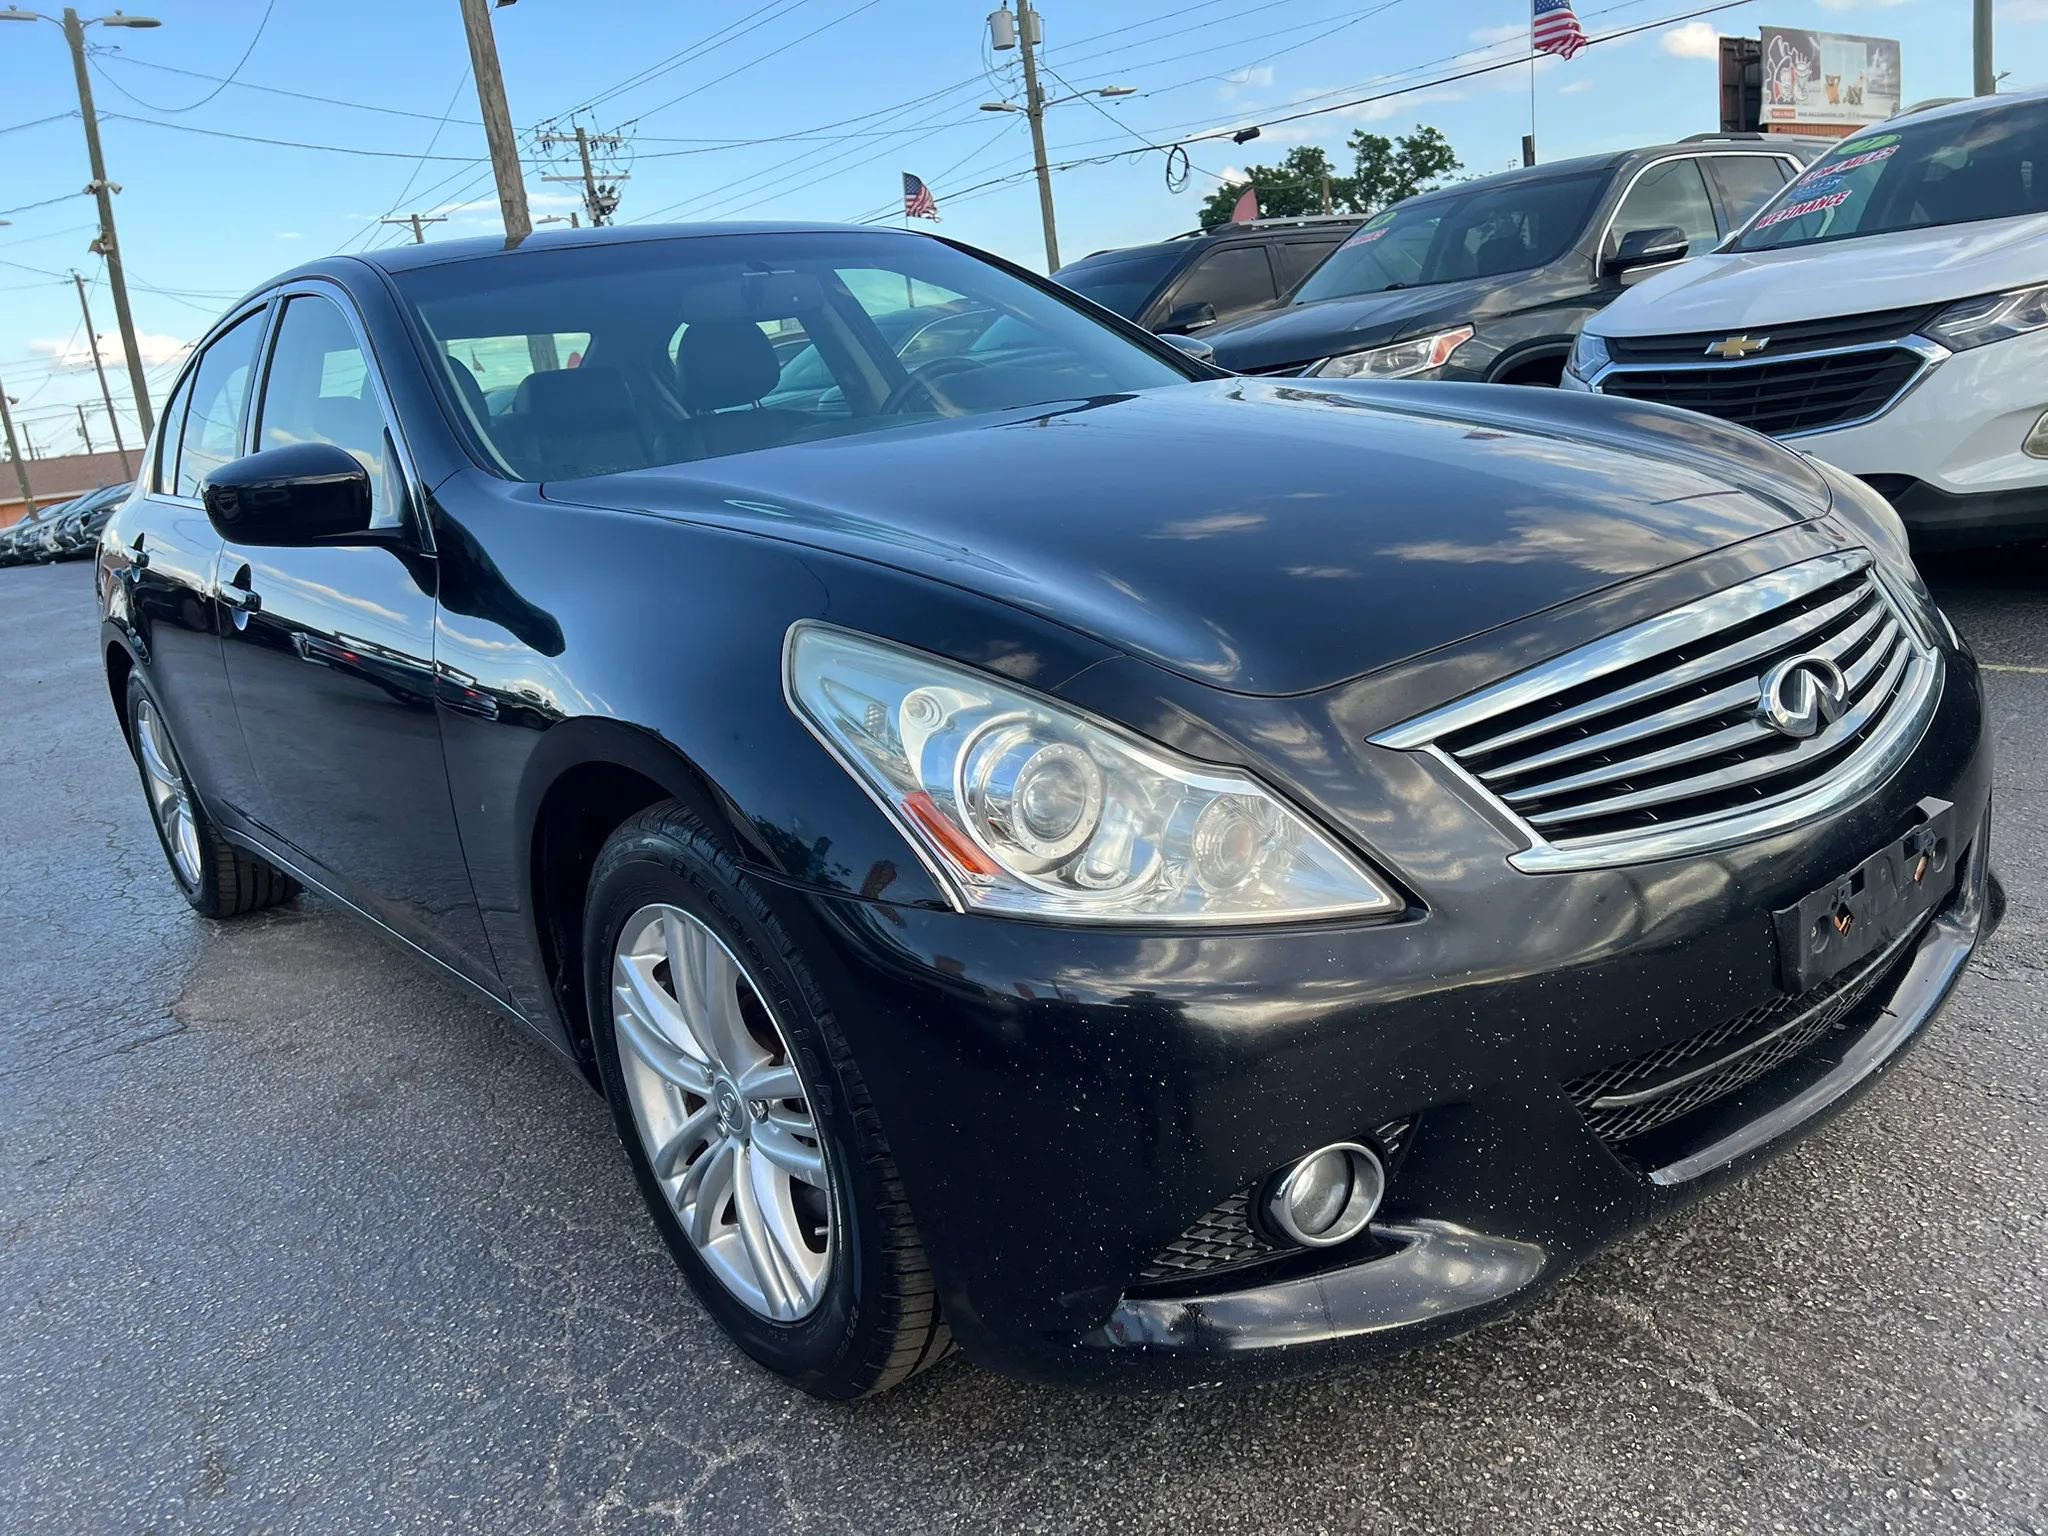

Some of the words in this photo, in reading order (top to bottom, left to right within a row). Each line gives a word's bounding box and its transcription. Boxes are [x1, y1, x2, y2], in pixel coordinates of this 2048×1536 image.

[1838, 145, 1899, 171] MILES
[1755, 209, 1781, 230] WE
[1780, 190, 1852, 220] FINANCE
